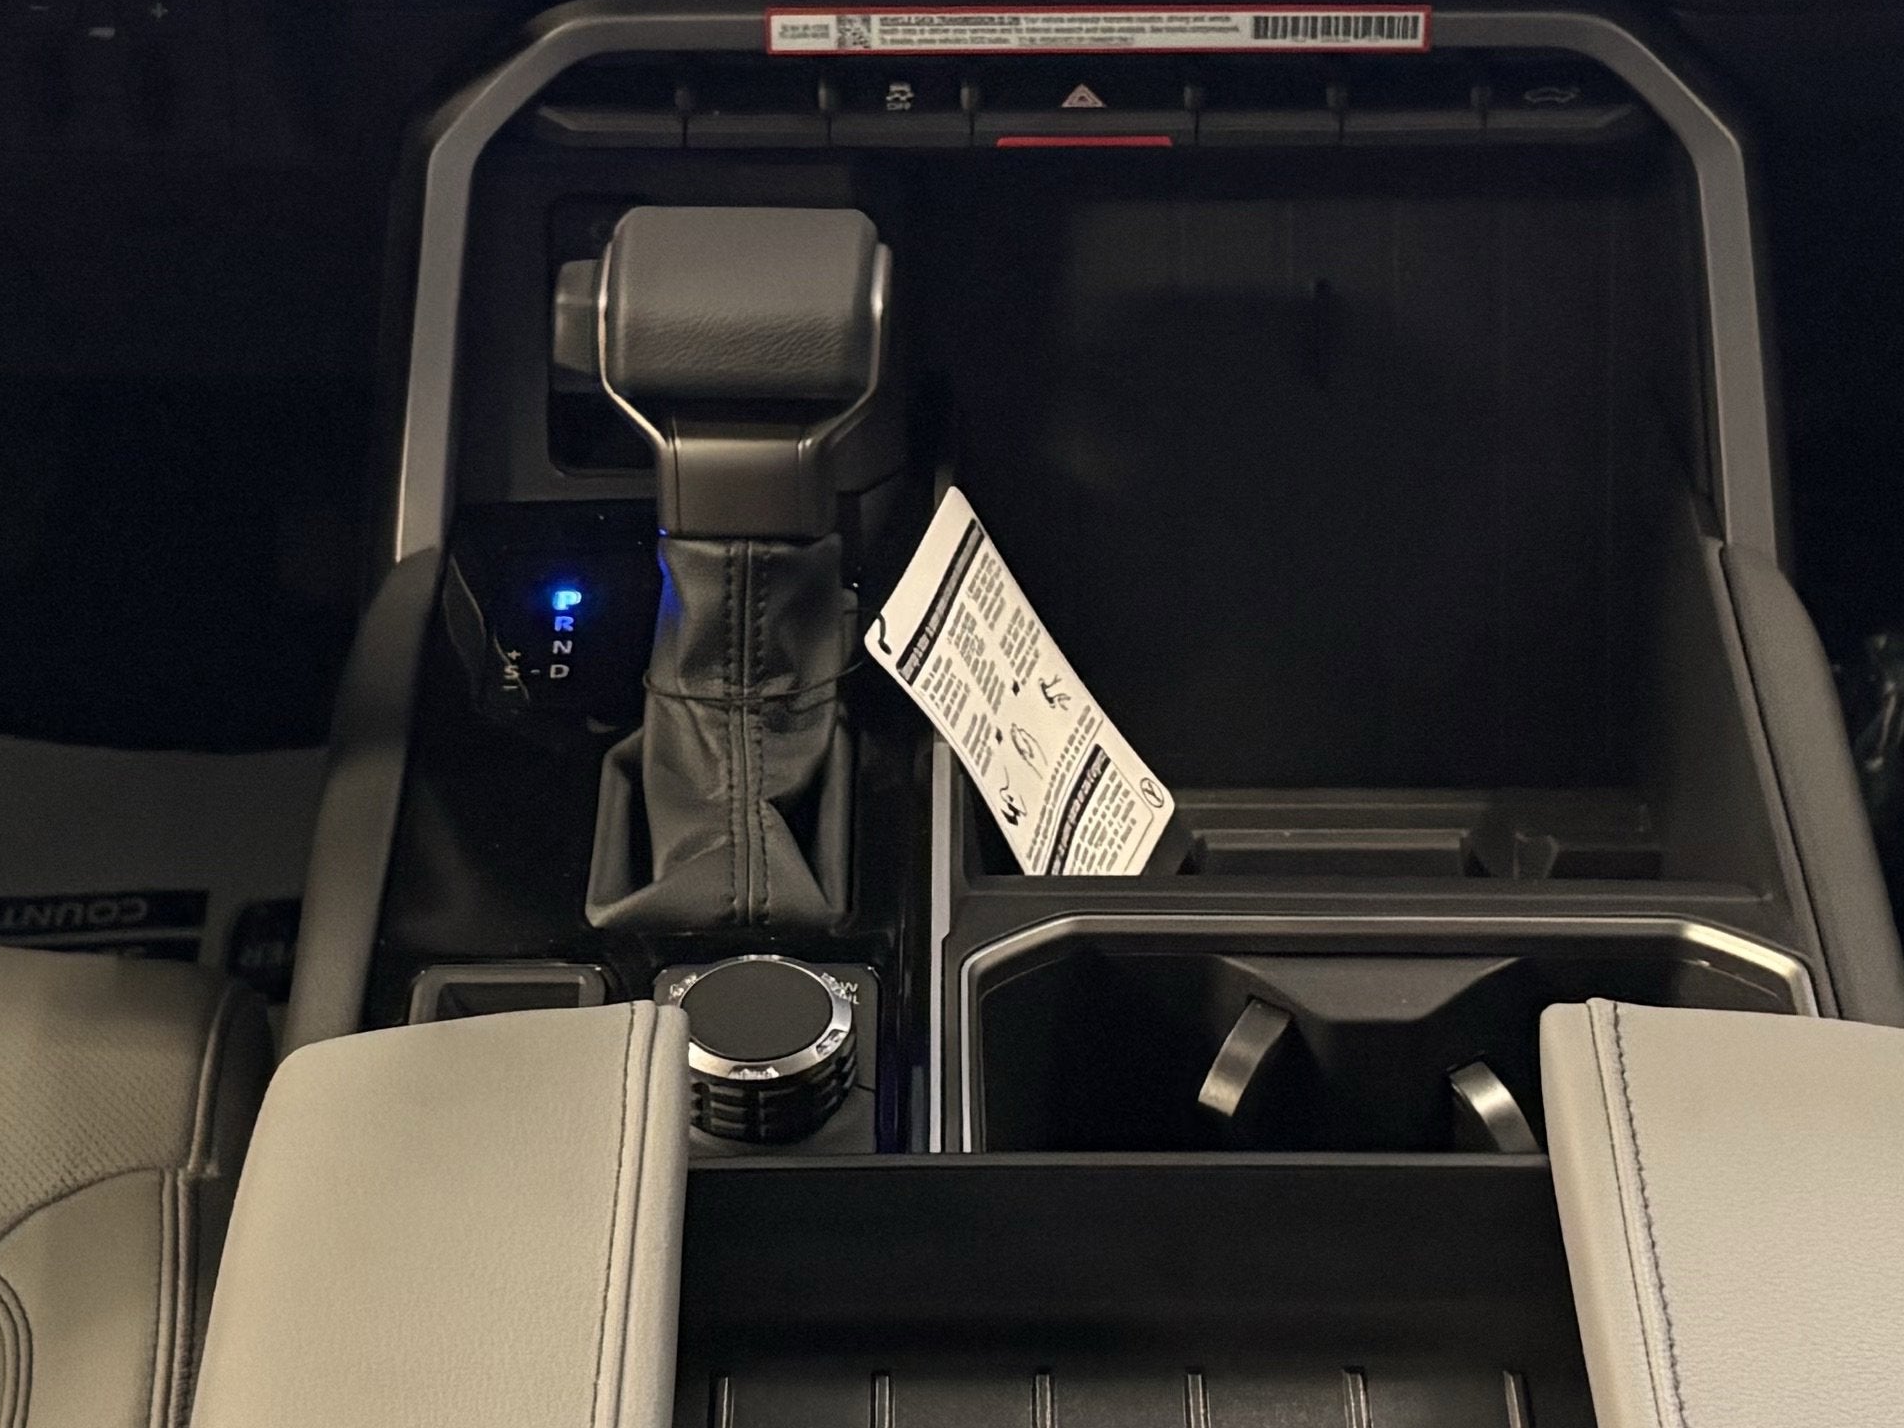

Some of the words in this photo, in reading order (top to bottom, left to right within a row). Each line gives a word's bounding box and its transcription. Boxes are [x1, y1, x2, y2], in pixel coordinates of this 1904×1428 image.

[552, 590, 582, 611] P
[554, 616, 574, 632] R
[552, 640, 573, 655] N
[504, 665, 520, 680] S
[550, 664, 570, 679] D
